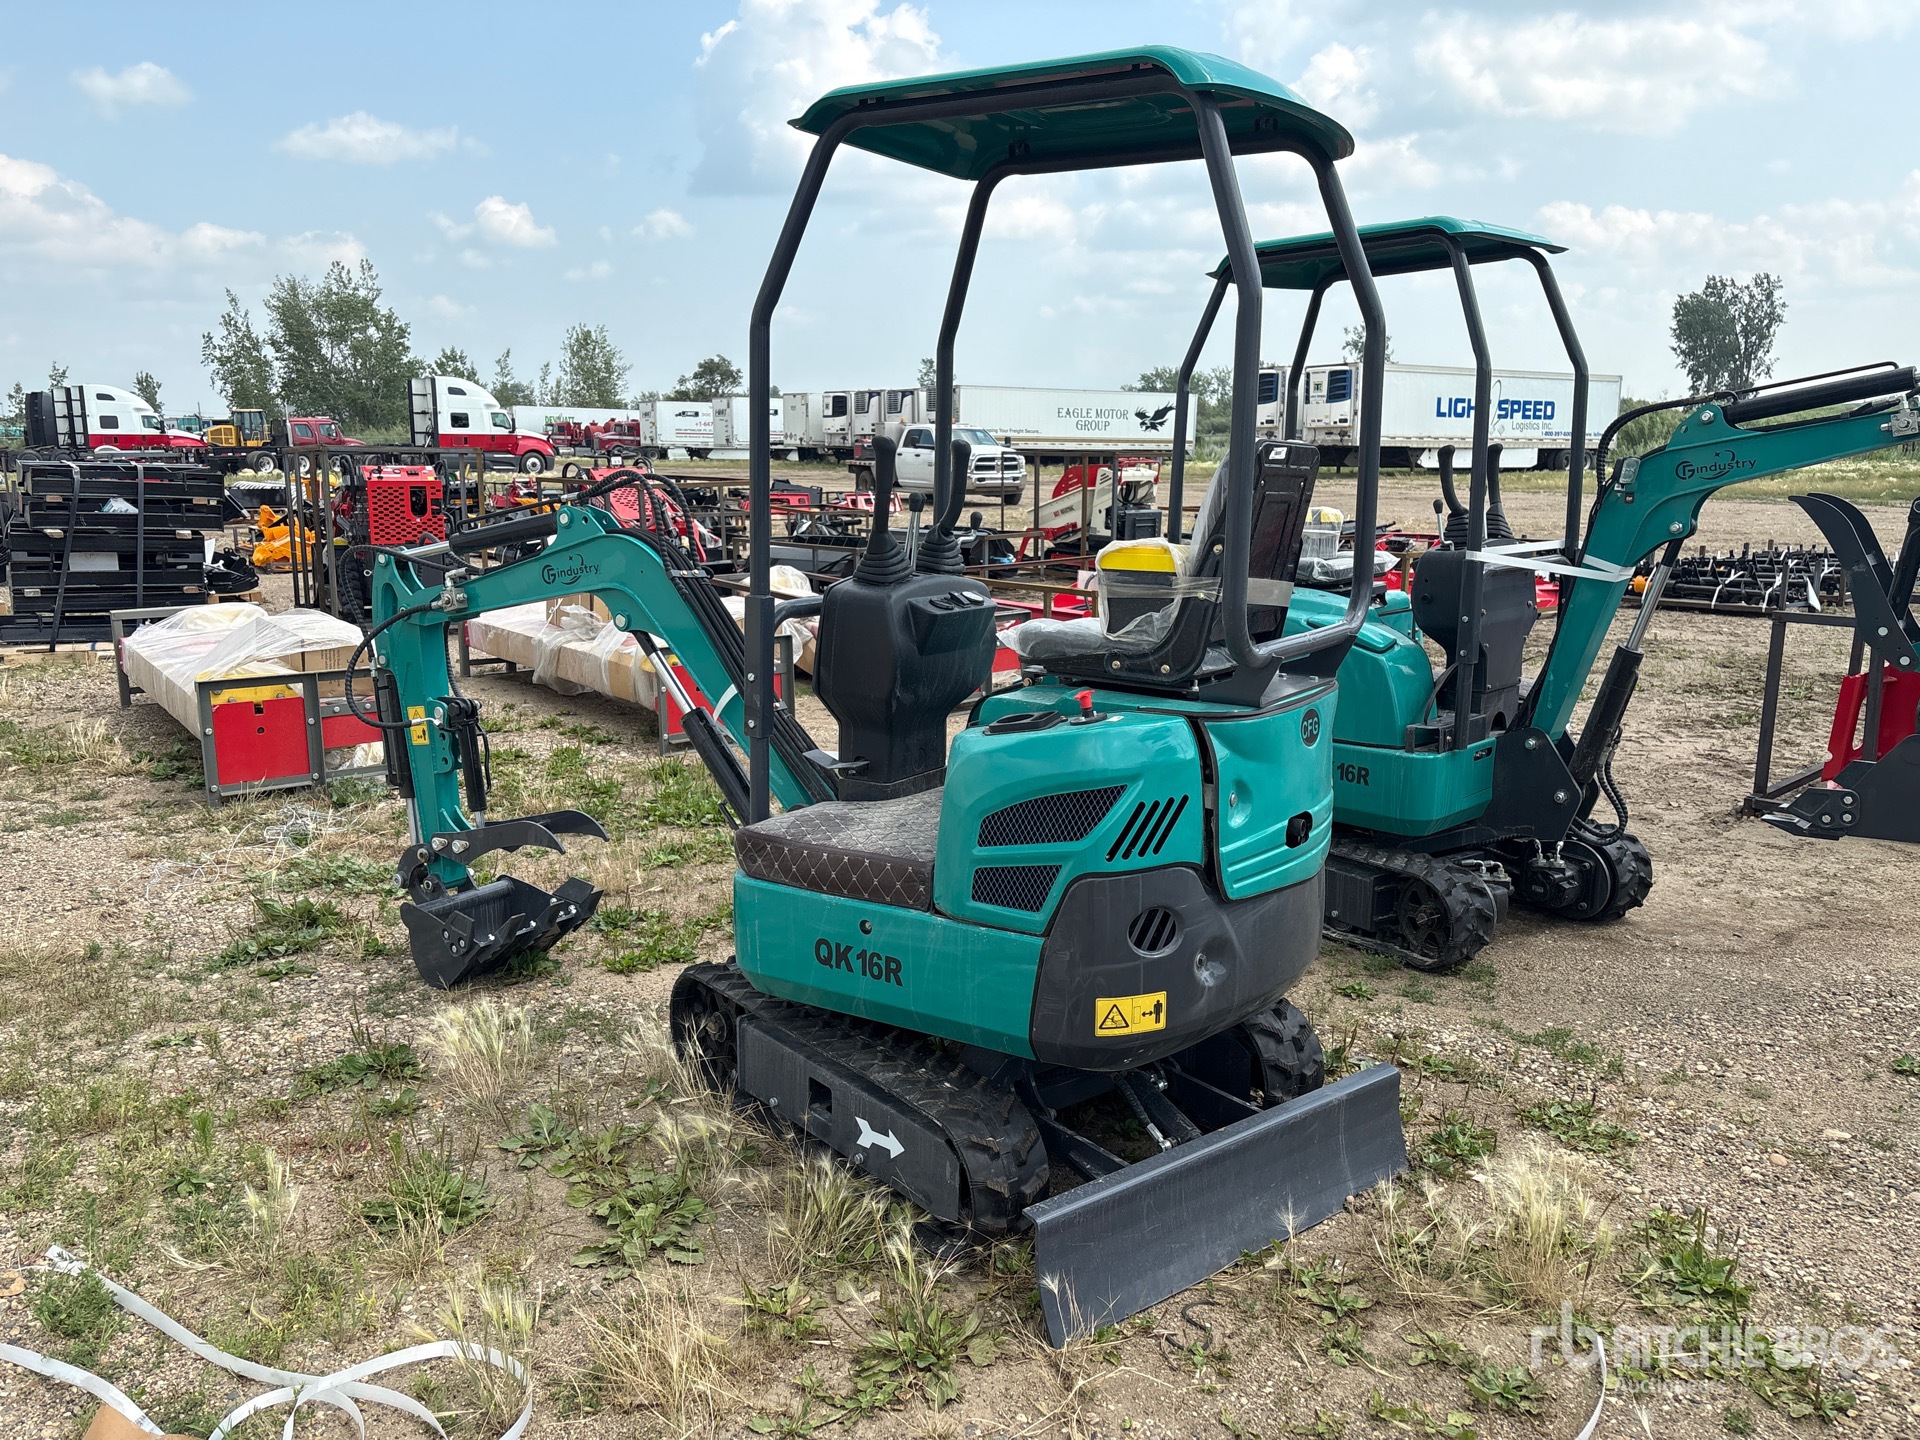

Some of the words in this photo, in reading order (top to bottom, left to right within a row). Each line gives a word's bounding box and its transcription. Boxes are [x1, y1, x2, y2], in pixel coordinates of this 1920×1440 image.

[1057, 408, 1092, 419] EAGLE
[1095, 408, 1129, 420] MOTOR
[1436, 397, 1477, 418] LIGH
[1497, 399, 1555, 420] SPEED
[1075, 420, 1110, 431] GROUP
[1511, 421, 1540, 433] Logistics
[1541, 422, 1553, 431] Inc.
[1302, 717, 1319, 739] CFG
